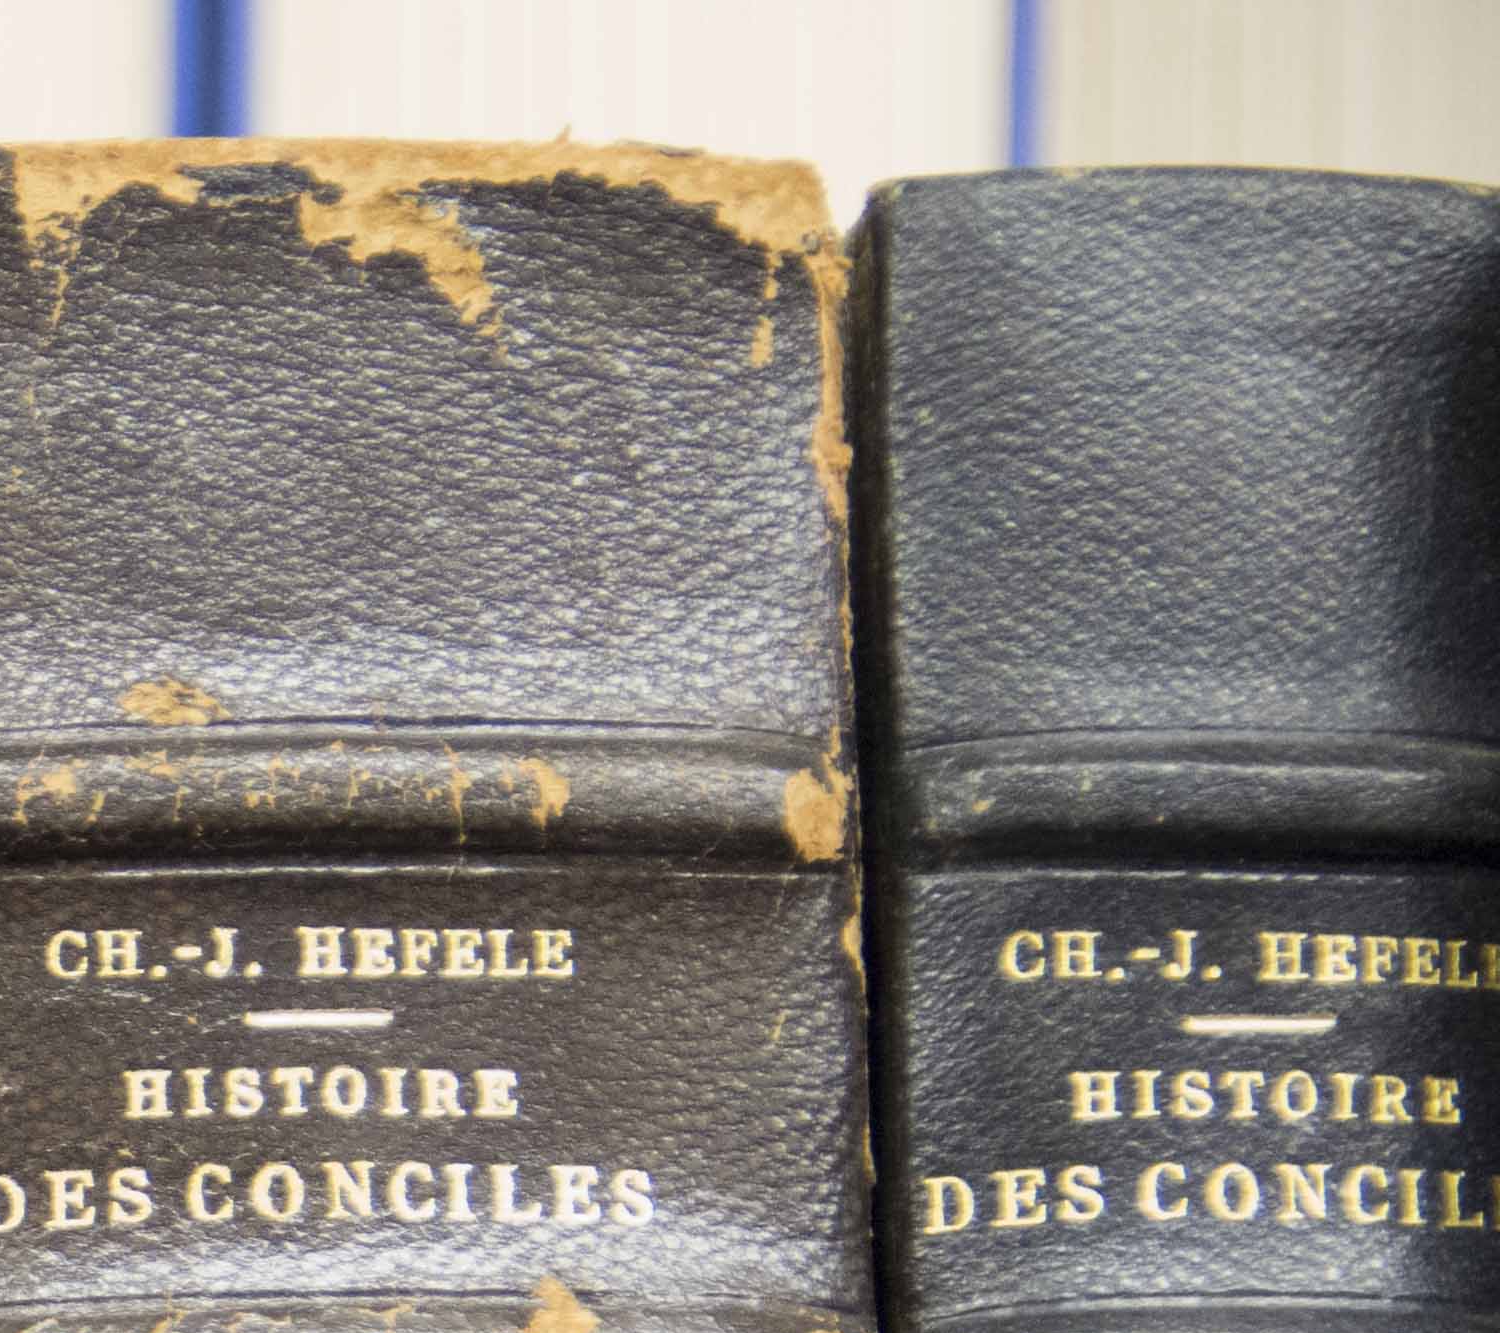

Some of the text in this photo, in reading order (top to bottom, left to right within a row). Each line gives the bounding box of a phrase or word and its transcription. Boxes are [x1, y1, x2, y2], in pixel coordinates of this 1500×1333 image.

[45, 926, 575, 980] CH.-J. HEFELE
[999, 928, 1223, 983] CH.-J.
[123, 1066, 521, 1120] HISTOIRE
[1069, 1070, 1462, 1125] HISTOIRE
[186, 1160, 658, 1227] CONCILES
[922, 1161, 1500, 1237] DES CONCIL
